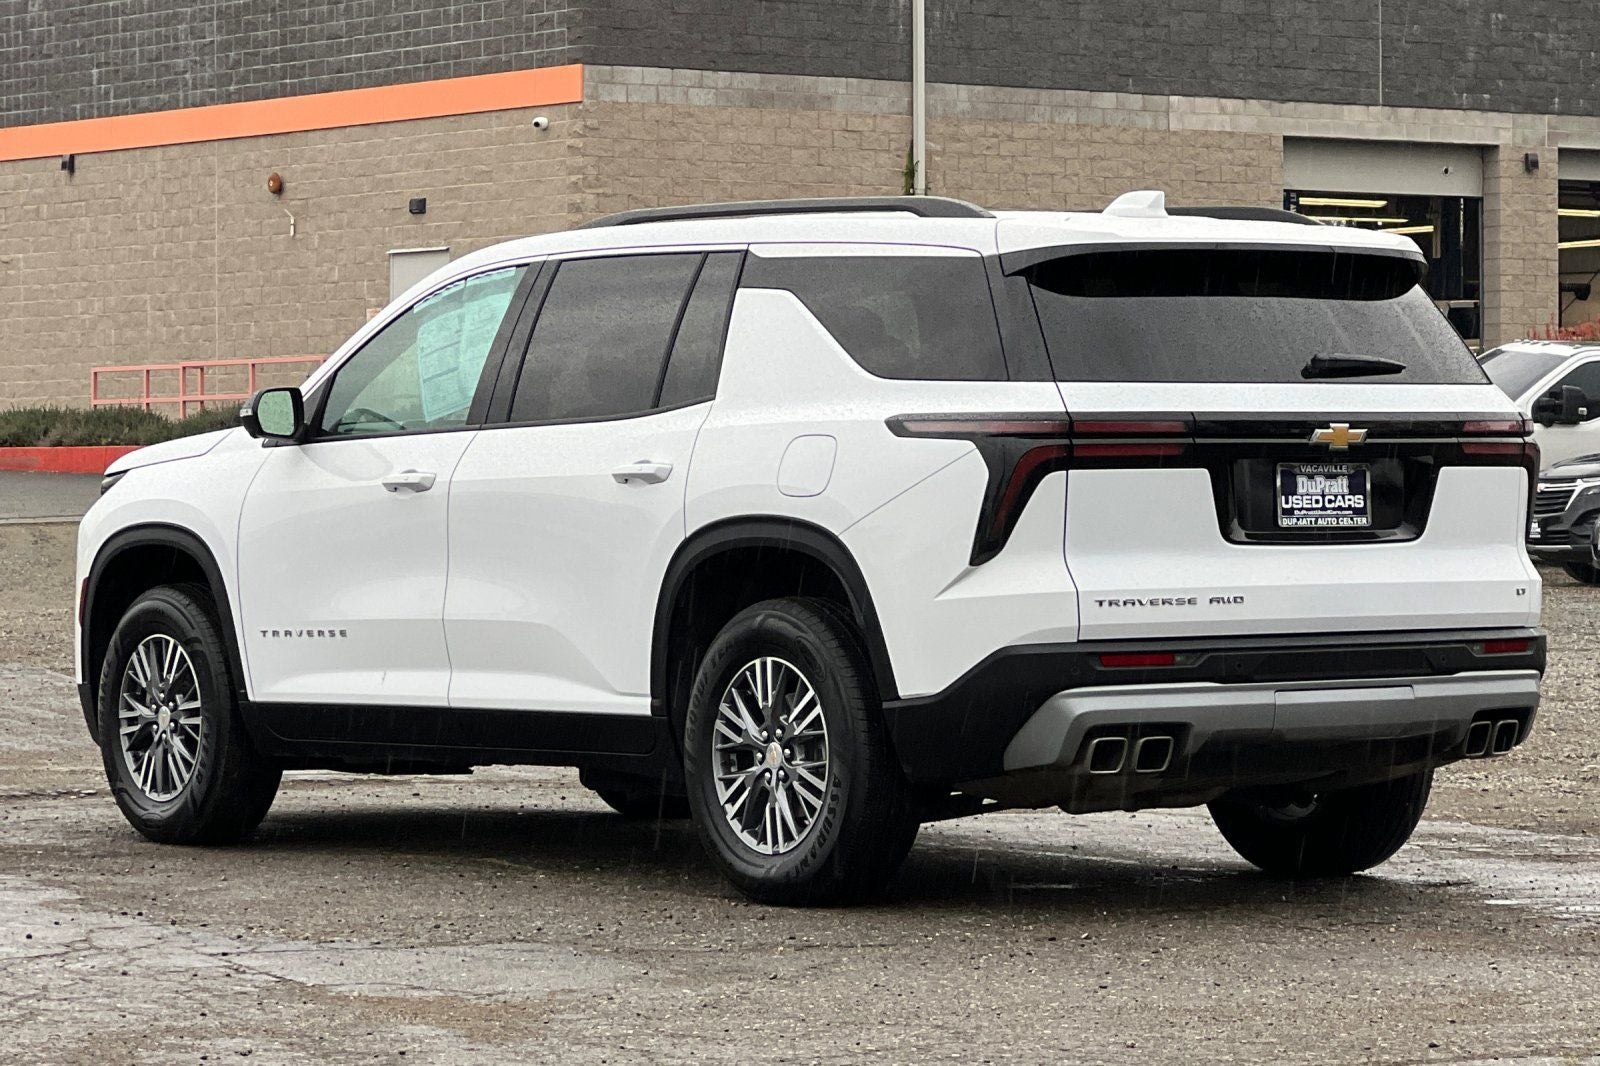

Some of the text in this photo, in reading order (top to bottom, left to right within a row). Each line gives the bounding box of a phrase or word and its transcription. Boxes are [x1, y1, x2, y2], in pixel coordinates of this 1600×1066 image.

[1300, 464, 1347, 473] VACAVILLE
[1296, 475, 1349, 494] DuPratt
[1281, 494, 1365, 508] USED CARS
[1317, 517, 1337, 525] AUTO
[1095, 596, 1244, 607] TRAVERSE AWD
[260, 629, 347, 638] TRAVERSE
